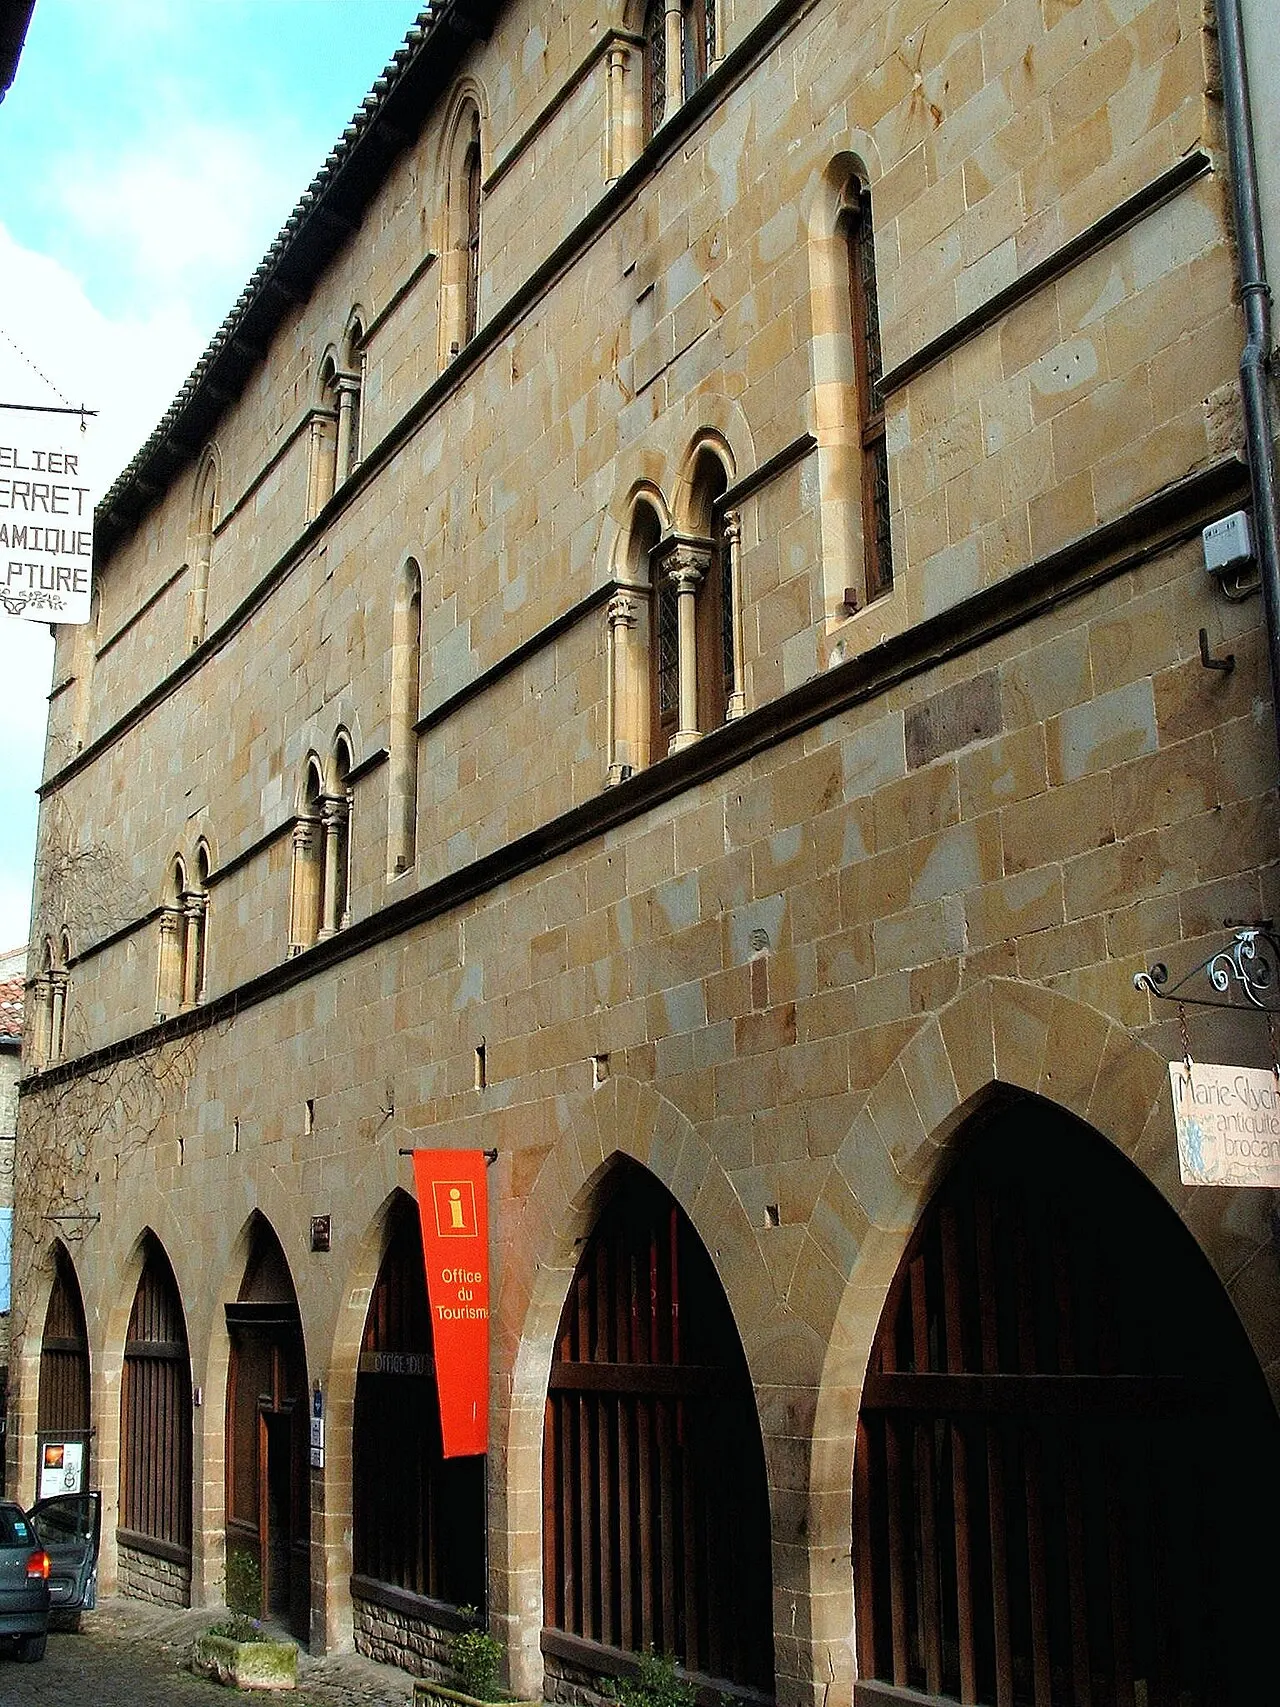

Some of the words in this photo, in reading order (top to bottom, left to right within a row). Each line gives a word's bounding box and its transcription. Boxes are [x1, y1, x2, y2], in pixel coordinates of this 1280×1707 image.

[0, 446, 78, 476] ELIER
[0, 478, 91, 516] ERRET
[0, 561, 88, 594] PTURE
[441, 1268, 482, 1284] Office
[457, 1286, 473, 1302] du
